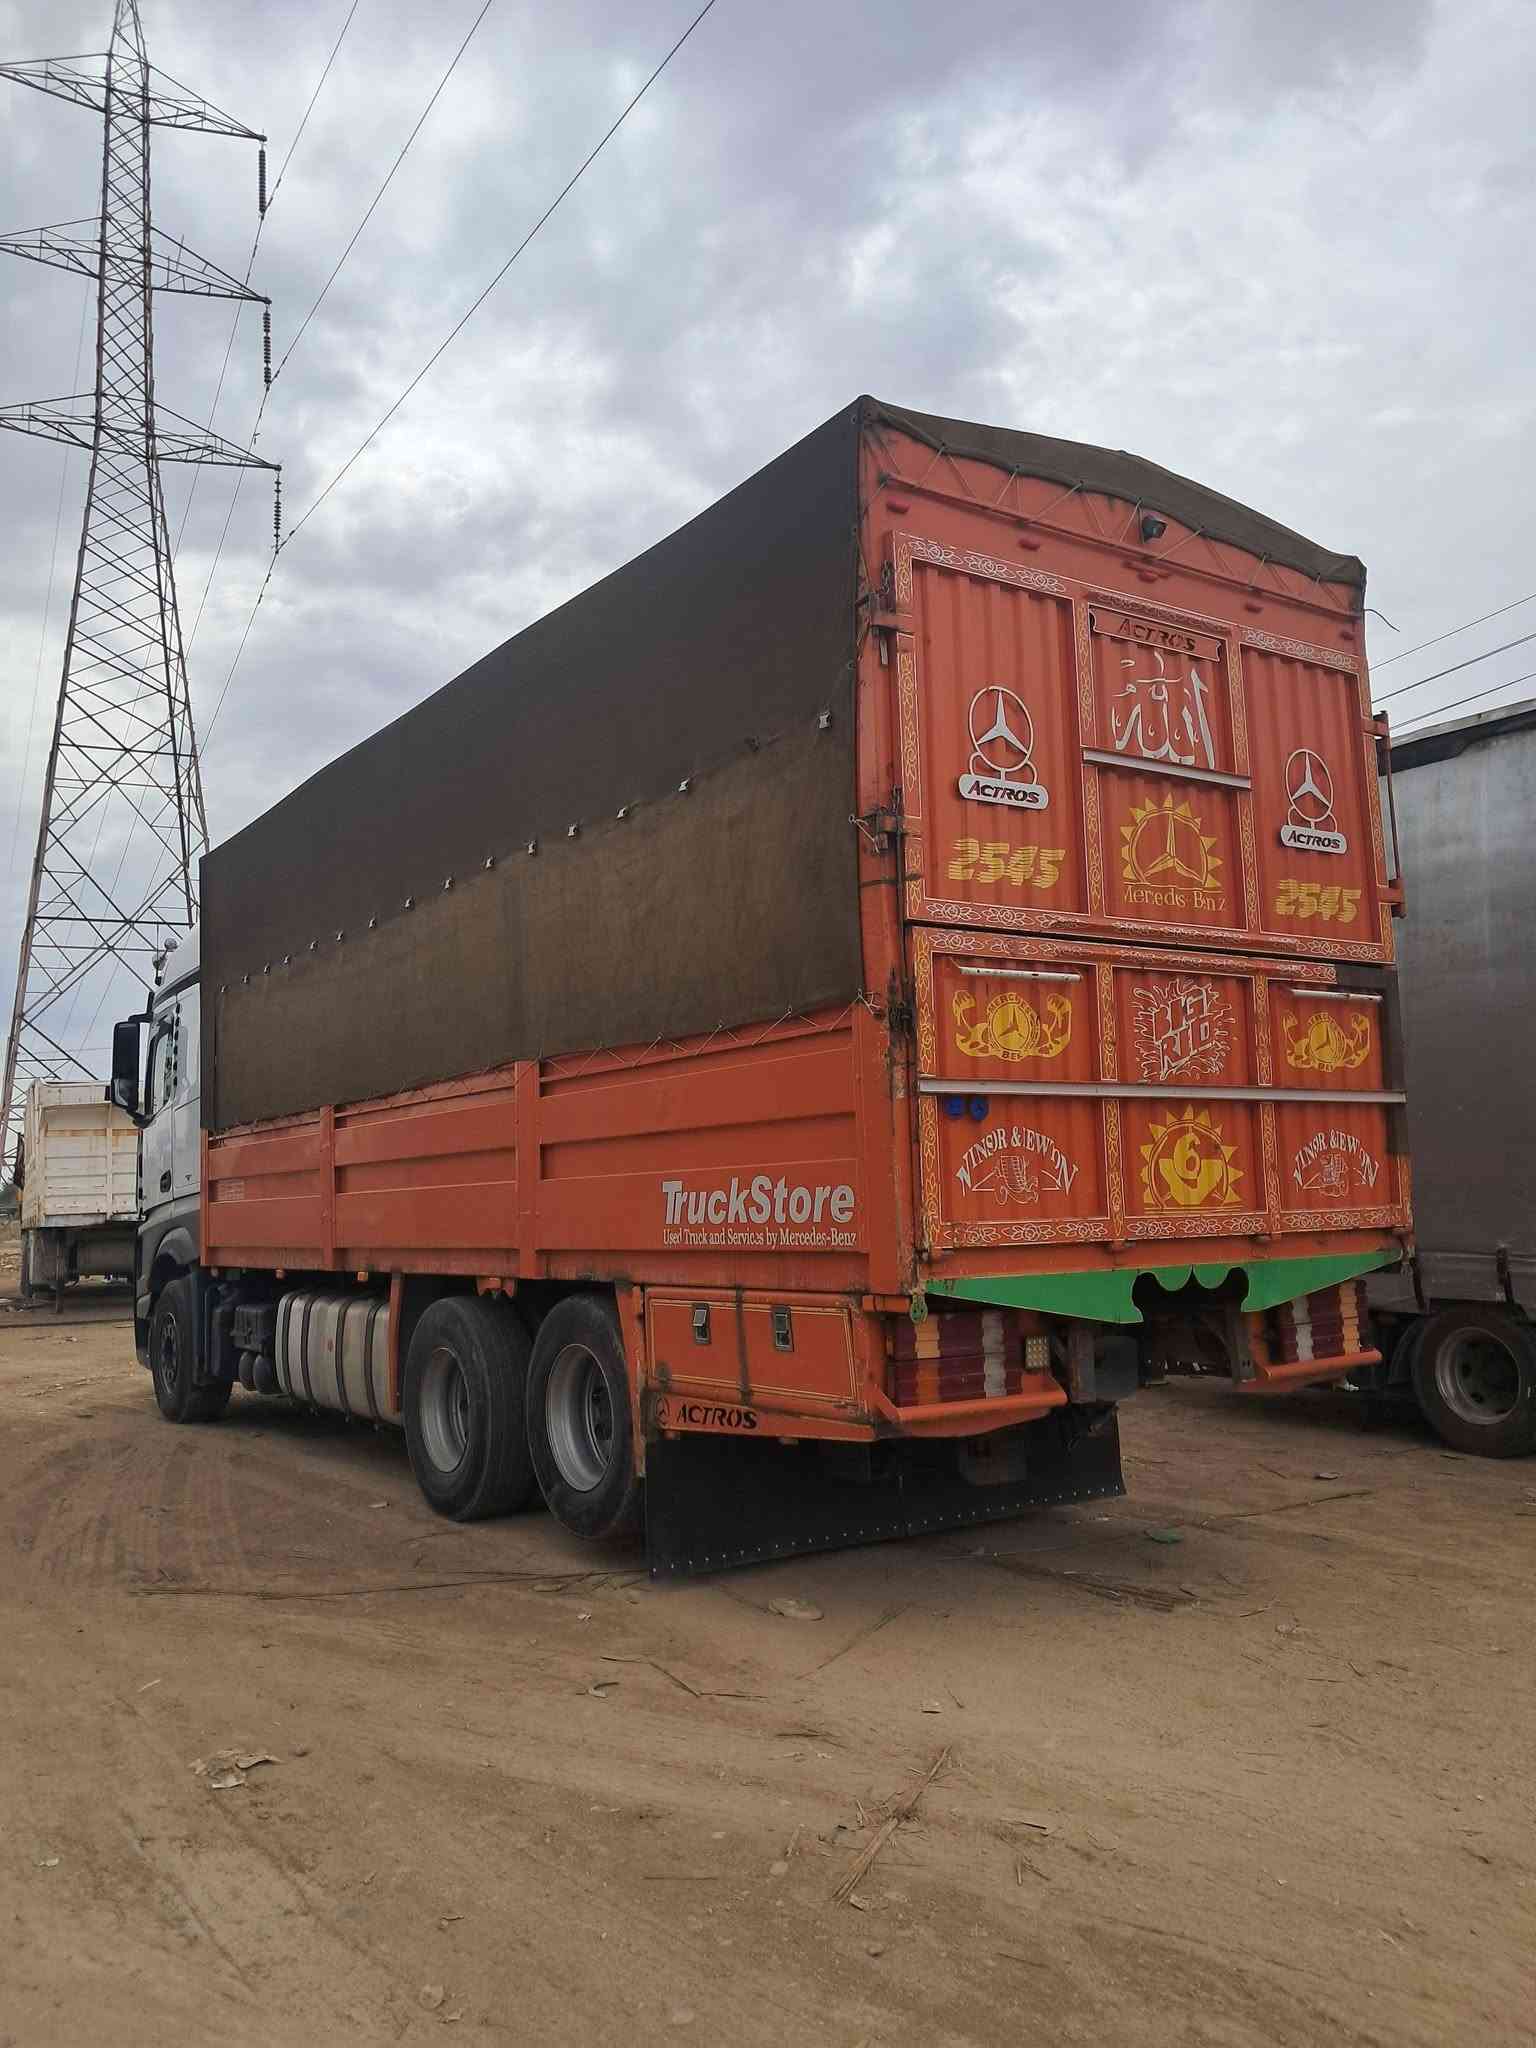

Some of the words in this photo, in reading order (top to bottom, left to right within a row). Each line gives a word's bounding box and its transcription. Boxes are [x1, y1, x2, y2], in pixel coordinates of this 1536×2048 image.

[1118, 617, 1197, 651] ACTROS
[967, 781, 1040, 804] ACTROS
[1287, 830, 1341, 849] ACTROS
[946, 837, 1067, 889] 2545
[1272, 878, 1362, 923] 2545
[1010, 1126, 1022, 1147] &
[1329, 1129, 1336, 1148] &
[662, 1175, 855, 1225] TruckStore
[663, 1229, 682, 1245] Used
[684, 1229, 707, 1245] Truck
[708, 1228, 726, 1245] and
[727, 1229, 764, 1246] Services
[766, 1227, 778, 1249] by
[780, 1228, 856, 1247] Mercedes-Benz
[676, 1406, 757, 1430] ACTROS
